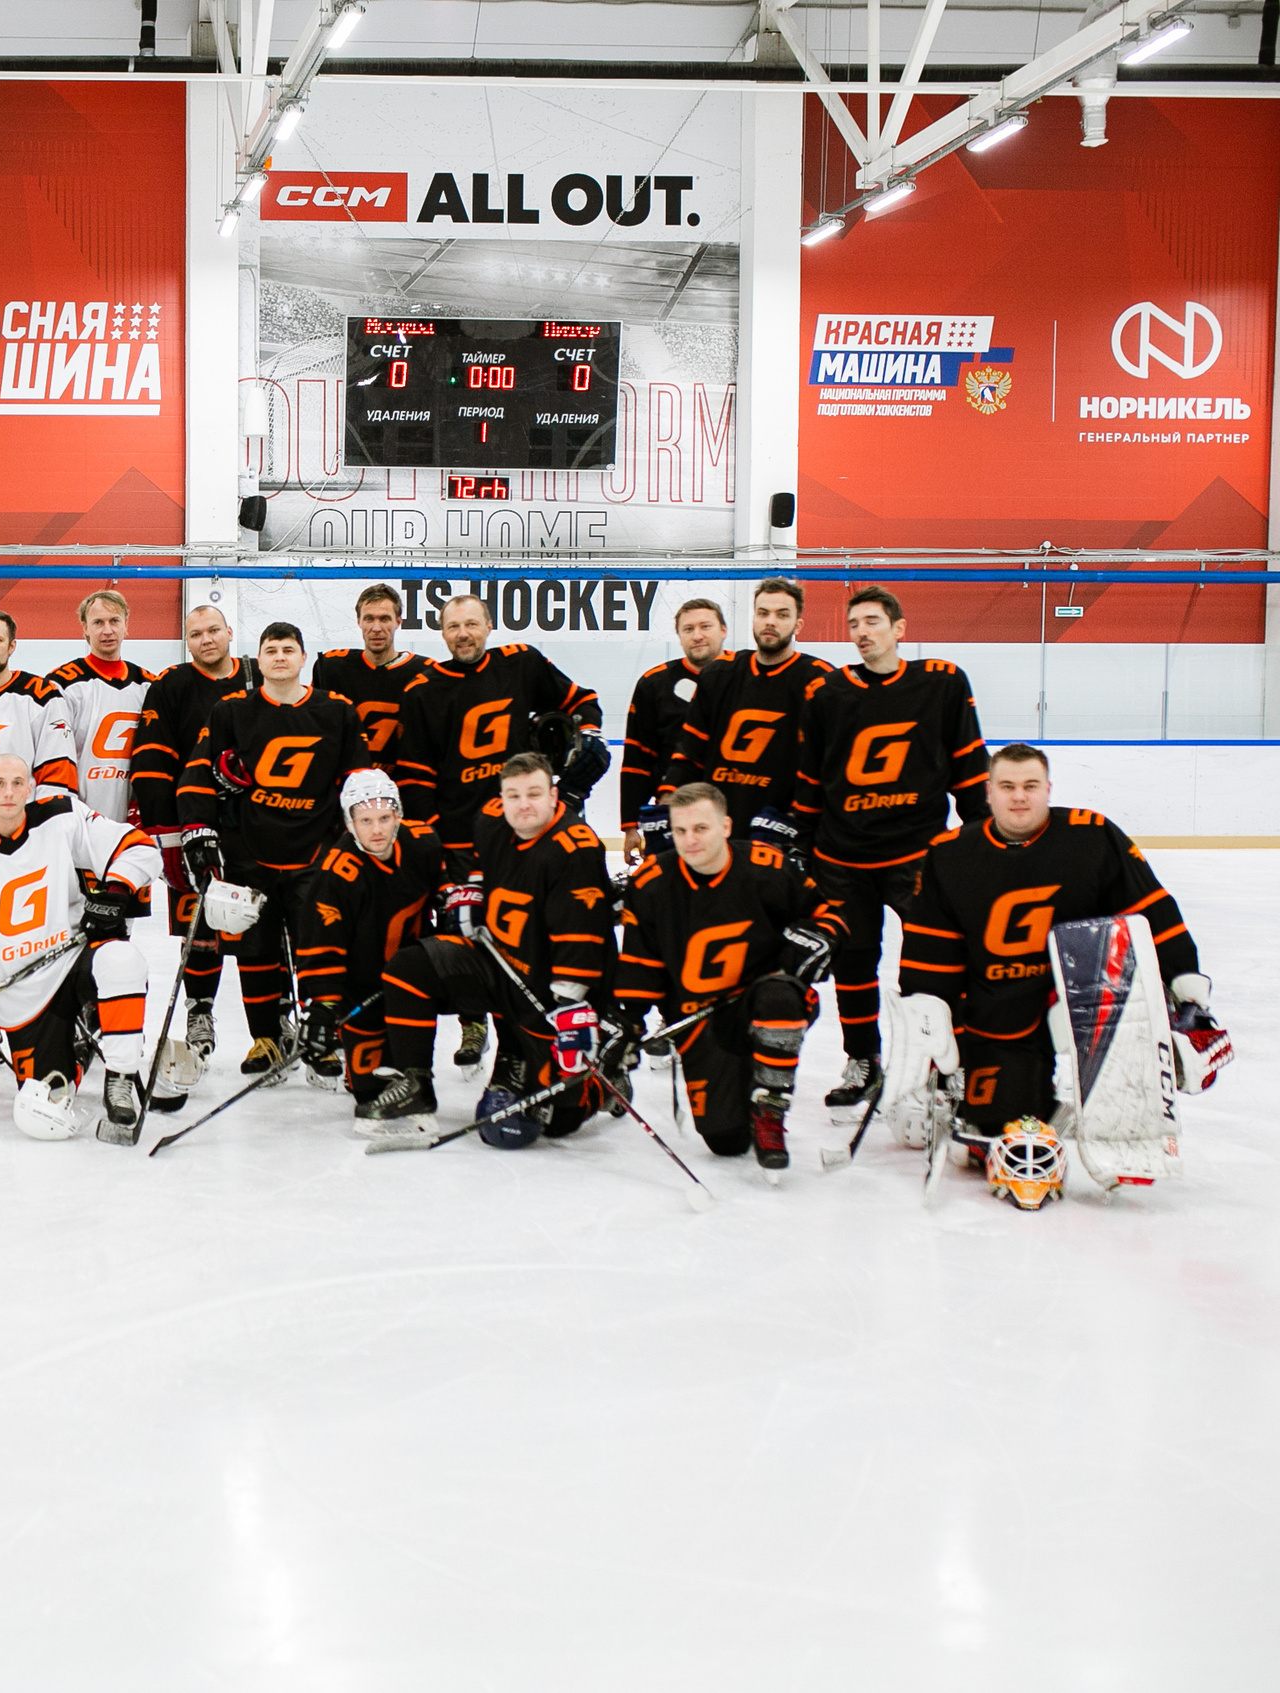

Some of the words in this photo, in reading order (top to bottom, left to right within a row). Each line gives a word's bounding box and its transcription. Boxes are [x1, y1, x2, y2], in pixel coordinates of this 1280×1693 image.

[275, 185, 393, 208] CCM
[416, 172, 540, 224] ALL
[550, 172, 701, 227] OUT.
[823, 321, 942, 346] КРАСНАЯ
[370, 344, 413, 359] СЧЕТ
[462, 350, 506, 364] ТАЙМЕР
[553, 347, 597, 362] СЧЕТ
[390, 361, 408, 388] 0
[469, 366, 515, 389] 0:00
[573, 364, 591, 391] 0
[817, 353, 942, 385] МАШИНА
[819, 387, 891, 401] НАЦИОНАЛЬНАЯ
[891, 389, 947, 401] ПРОГРАММА
[367, 409, 431, 422] УДАЛЕНИЯ
[458, 406, 505, 419] ПЕРИОД
[535, 412, 600, 425] УДАЛЕНИЯ
[817, 403, 875, 417] ПОДГОТОВКИ
[875, 404, 933, 417] ХОККЕИСТОВ
[1079, 396, 1252, 420] НОРНИКЕЛЬ
[1078, 430, 1182, 444] ГЕНЕРАЛЬНЫЙ
[1186, 432, 1250, 444] ПАРТНЕР
[309, 508, 428, 567] OUR
[446, 509, 608, 567] HOME
[400, 580, 452, 630] IS
[476, 580, 659, 631] HOCKEY
[552, 824, 600, 854] 19
[321, 847, 364, 883] 16
[1157, 1041, 1176, 1121] CCM
